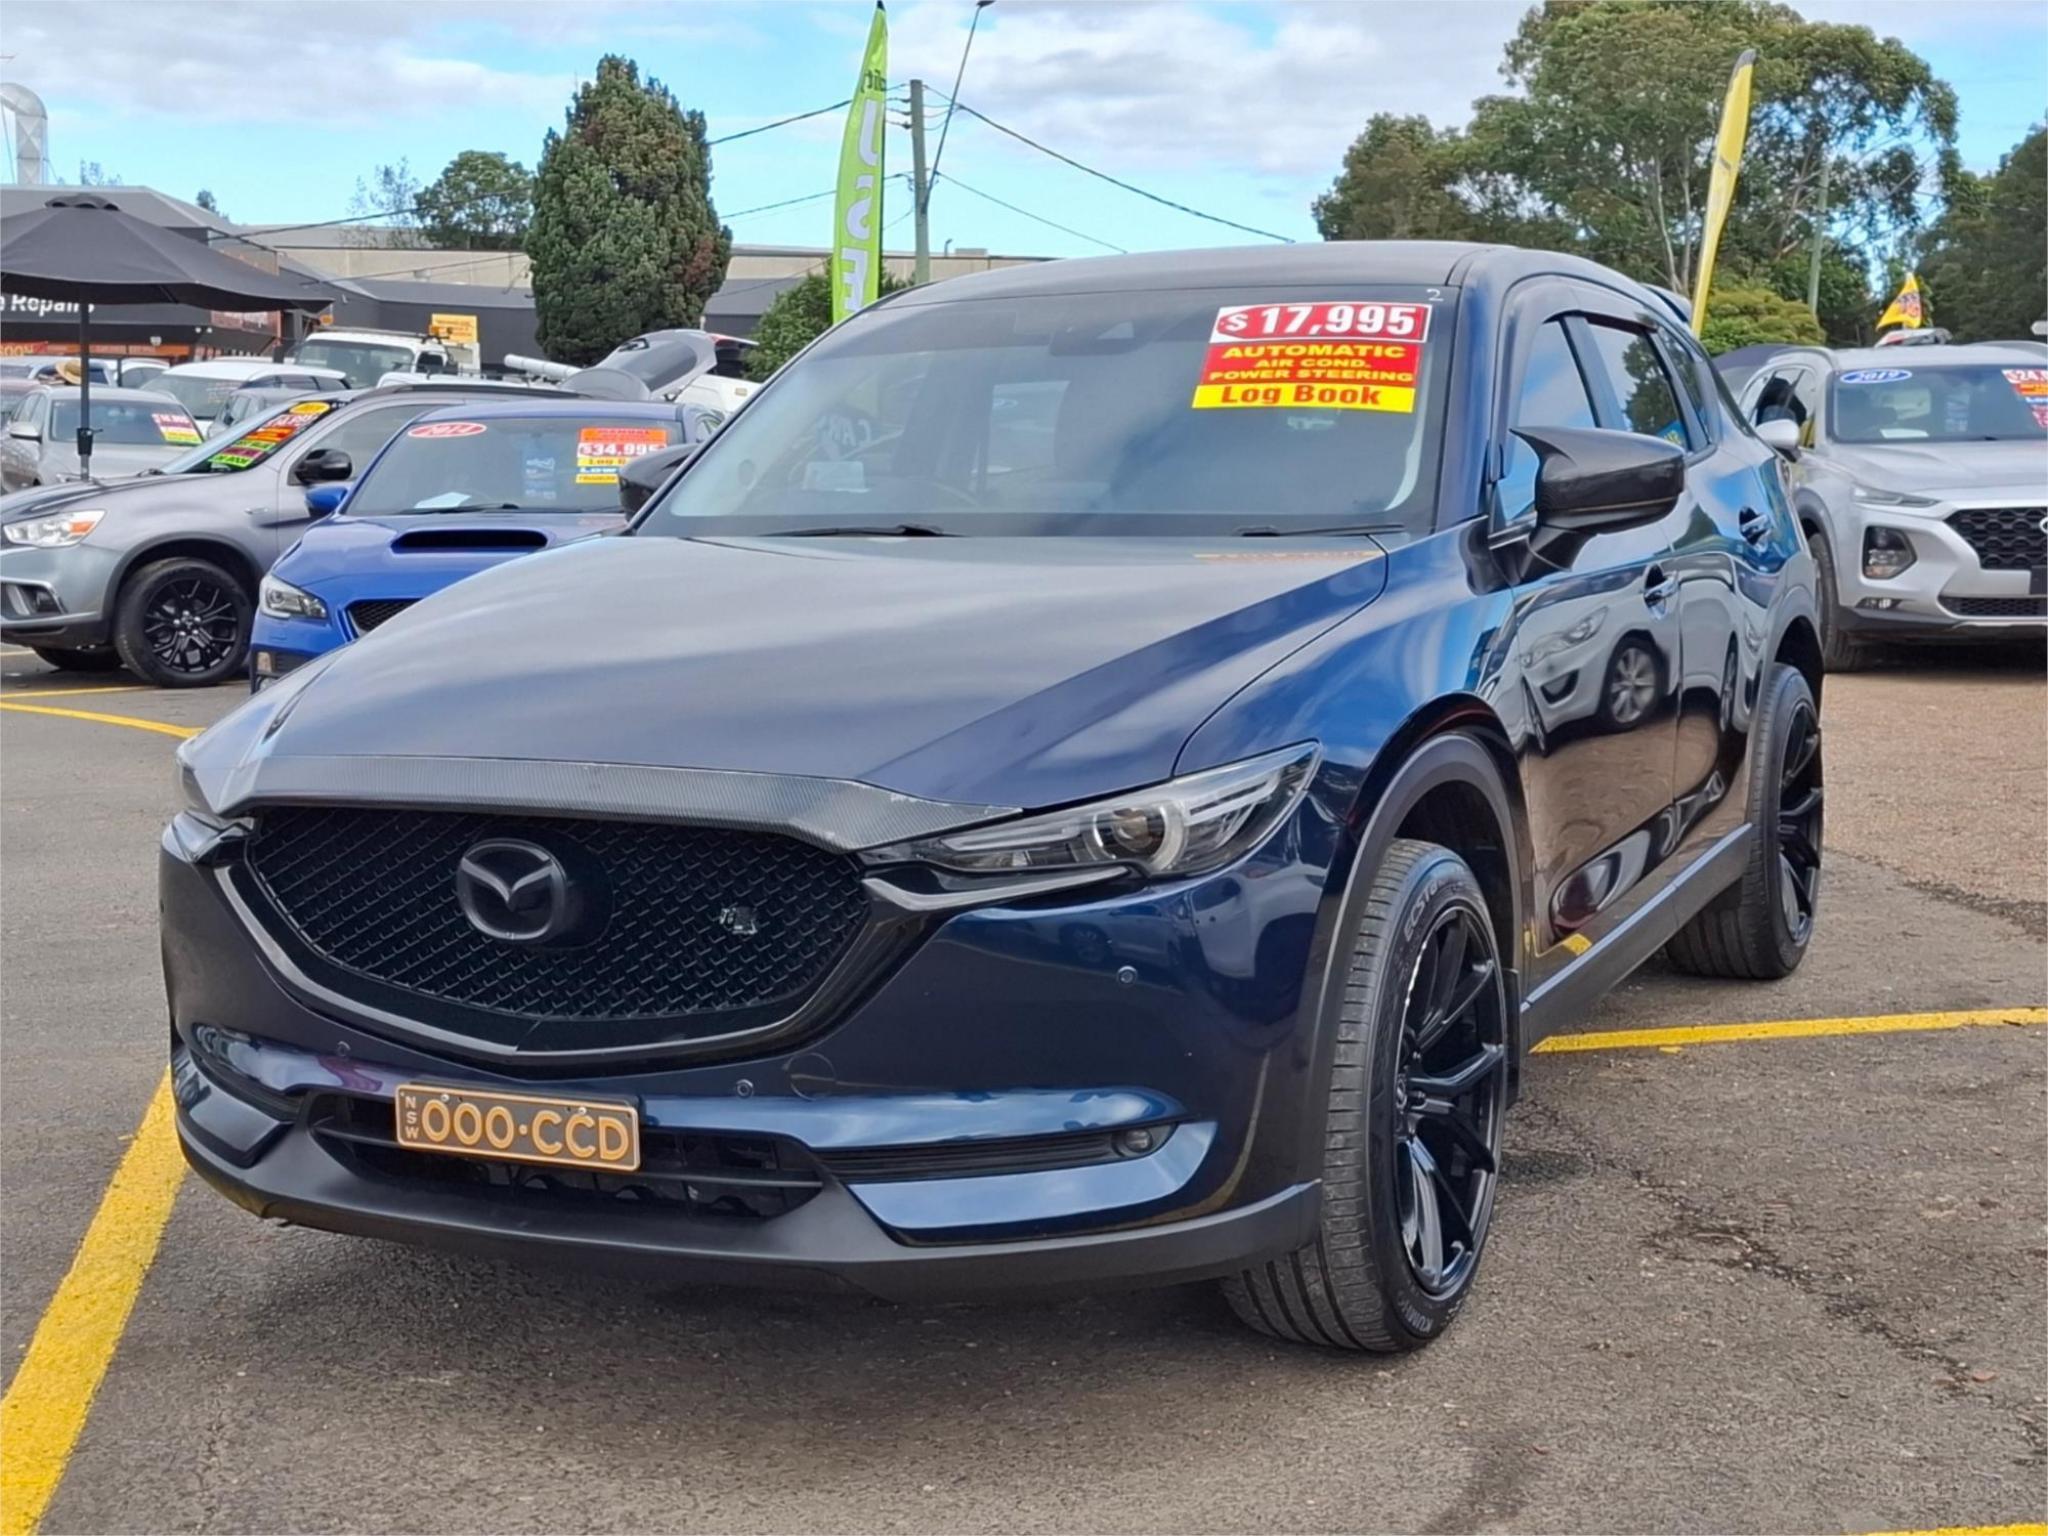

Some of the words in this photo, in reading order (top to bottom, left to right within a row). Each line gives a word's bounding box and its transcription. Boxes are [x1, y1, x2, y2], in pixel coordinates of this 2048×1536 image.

[1221, 345, 1406, 359] AUTOMATIC
[1254, 358, 1295, 368] AIR
[1300, 358, 1372, 369] COND.
[1208, 369, 1290, 382] POWER
[1296, 369, 1414, 382] STEERING
[1220, 386, 1282, 406] Log
[1293, 385, 1381, 405] Book
